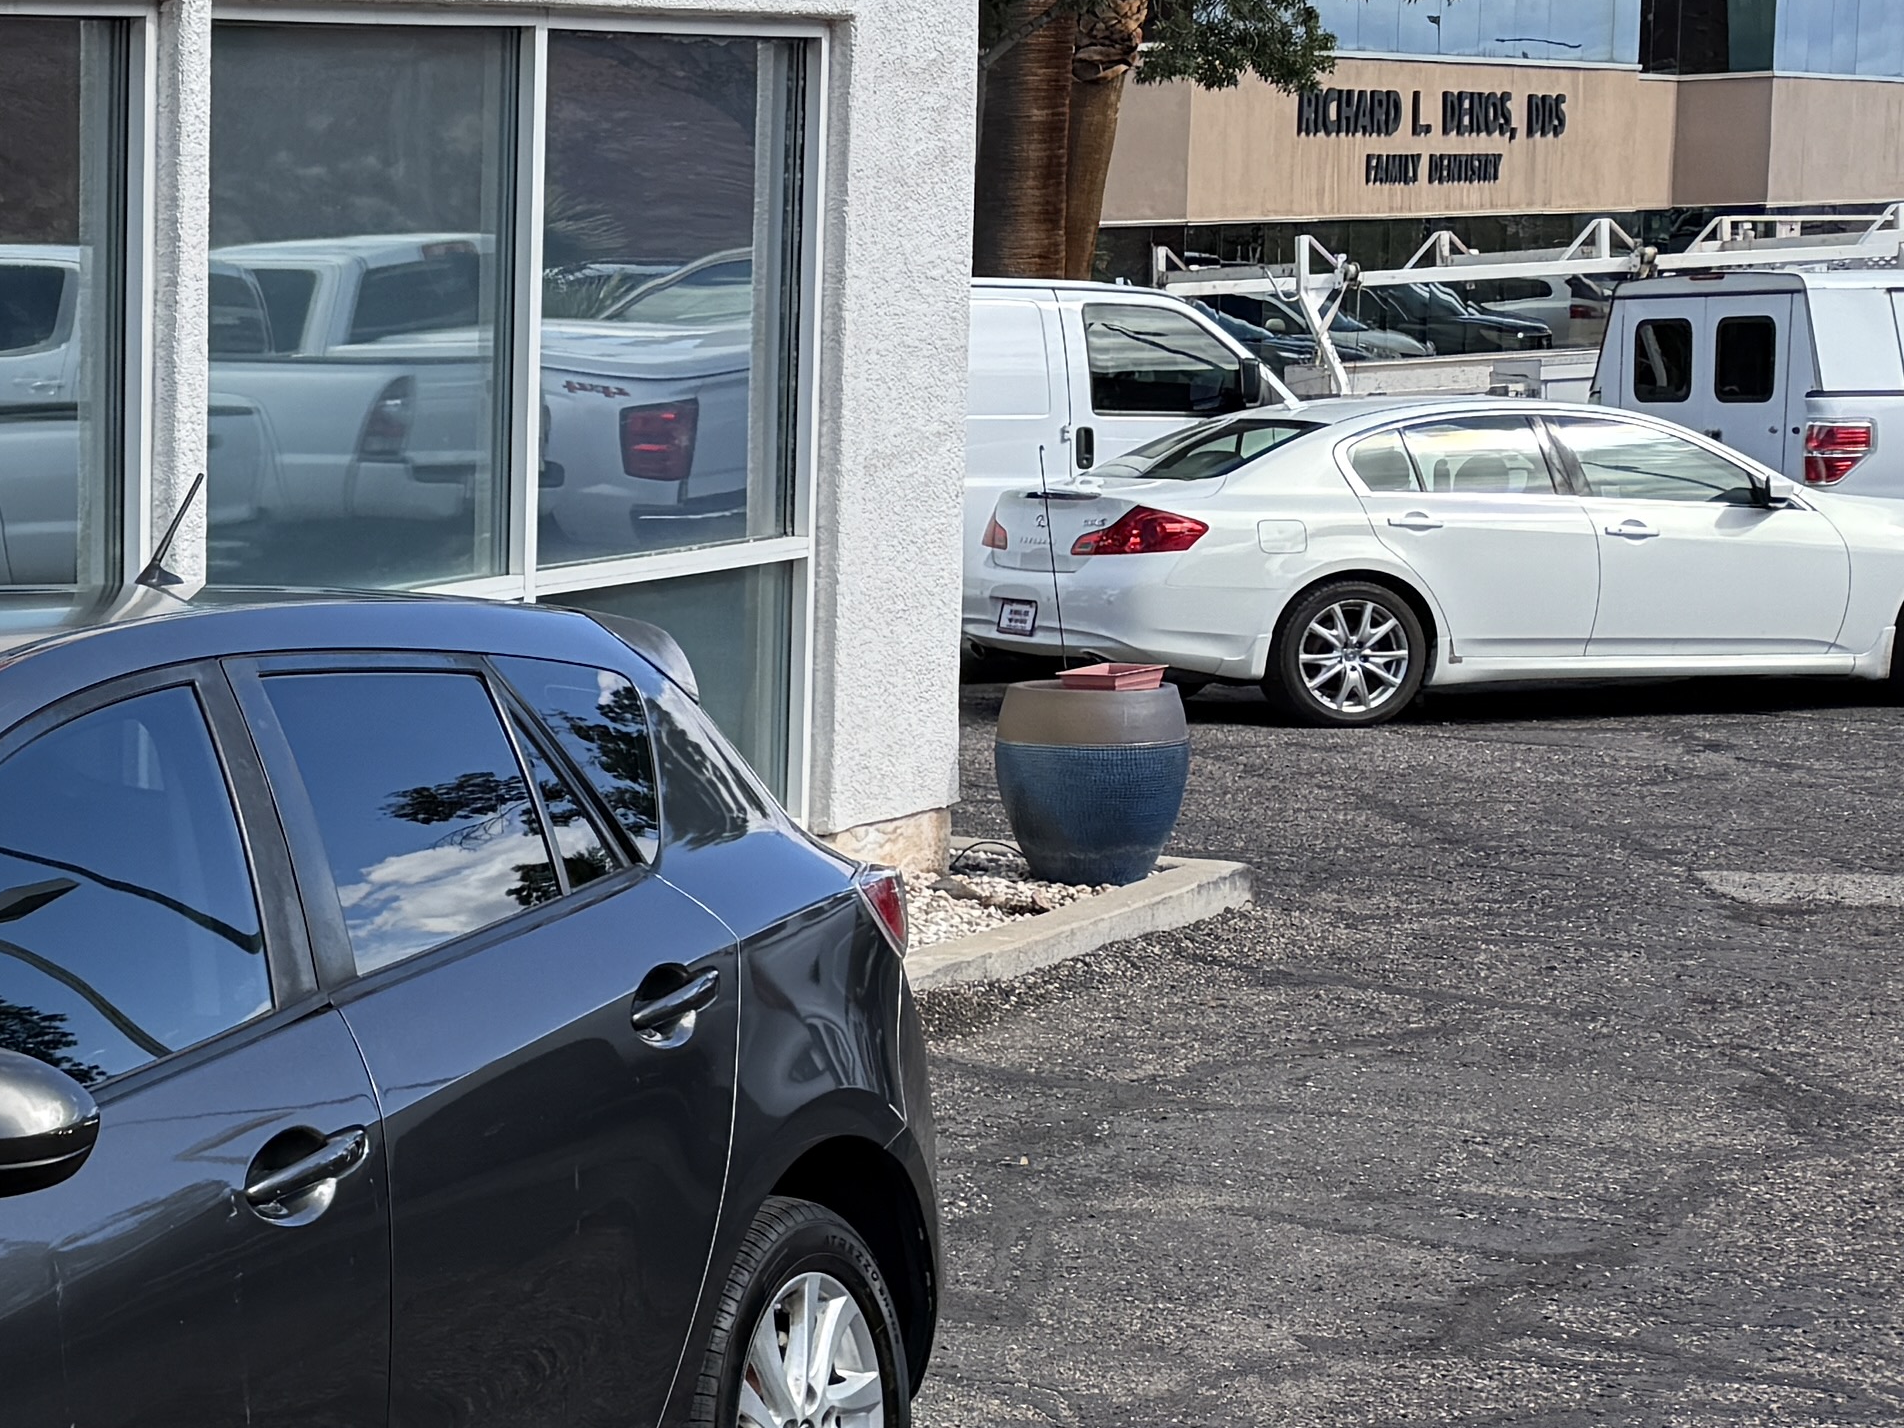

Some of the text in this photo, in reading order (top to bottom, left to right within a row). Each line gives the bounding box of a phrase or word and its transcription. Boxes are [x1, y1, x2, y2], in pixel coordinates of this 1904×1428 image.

[1297, 87, 1566, 143] RICHARD L. DENOS, DDS
[1365, 153, 1504, 186] FAMILY DENTISTRY
